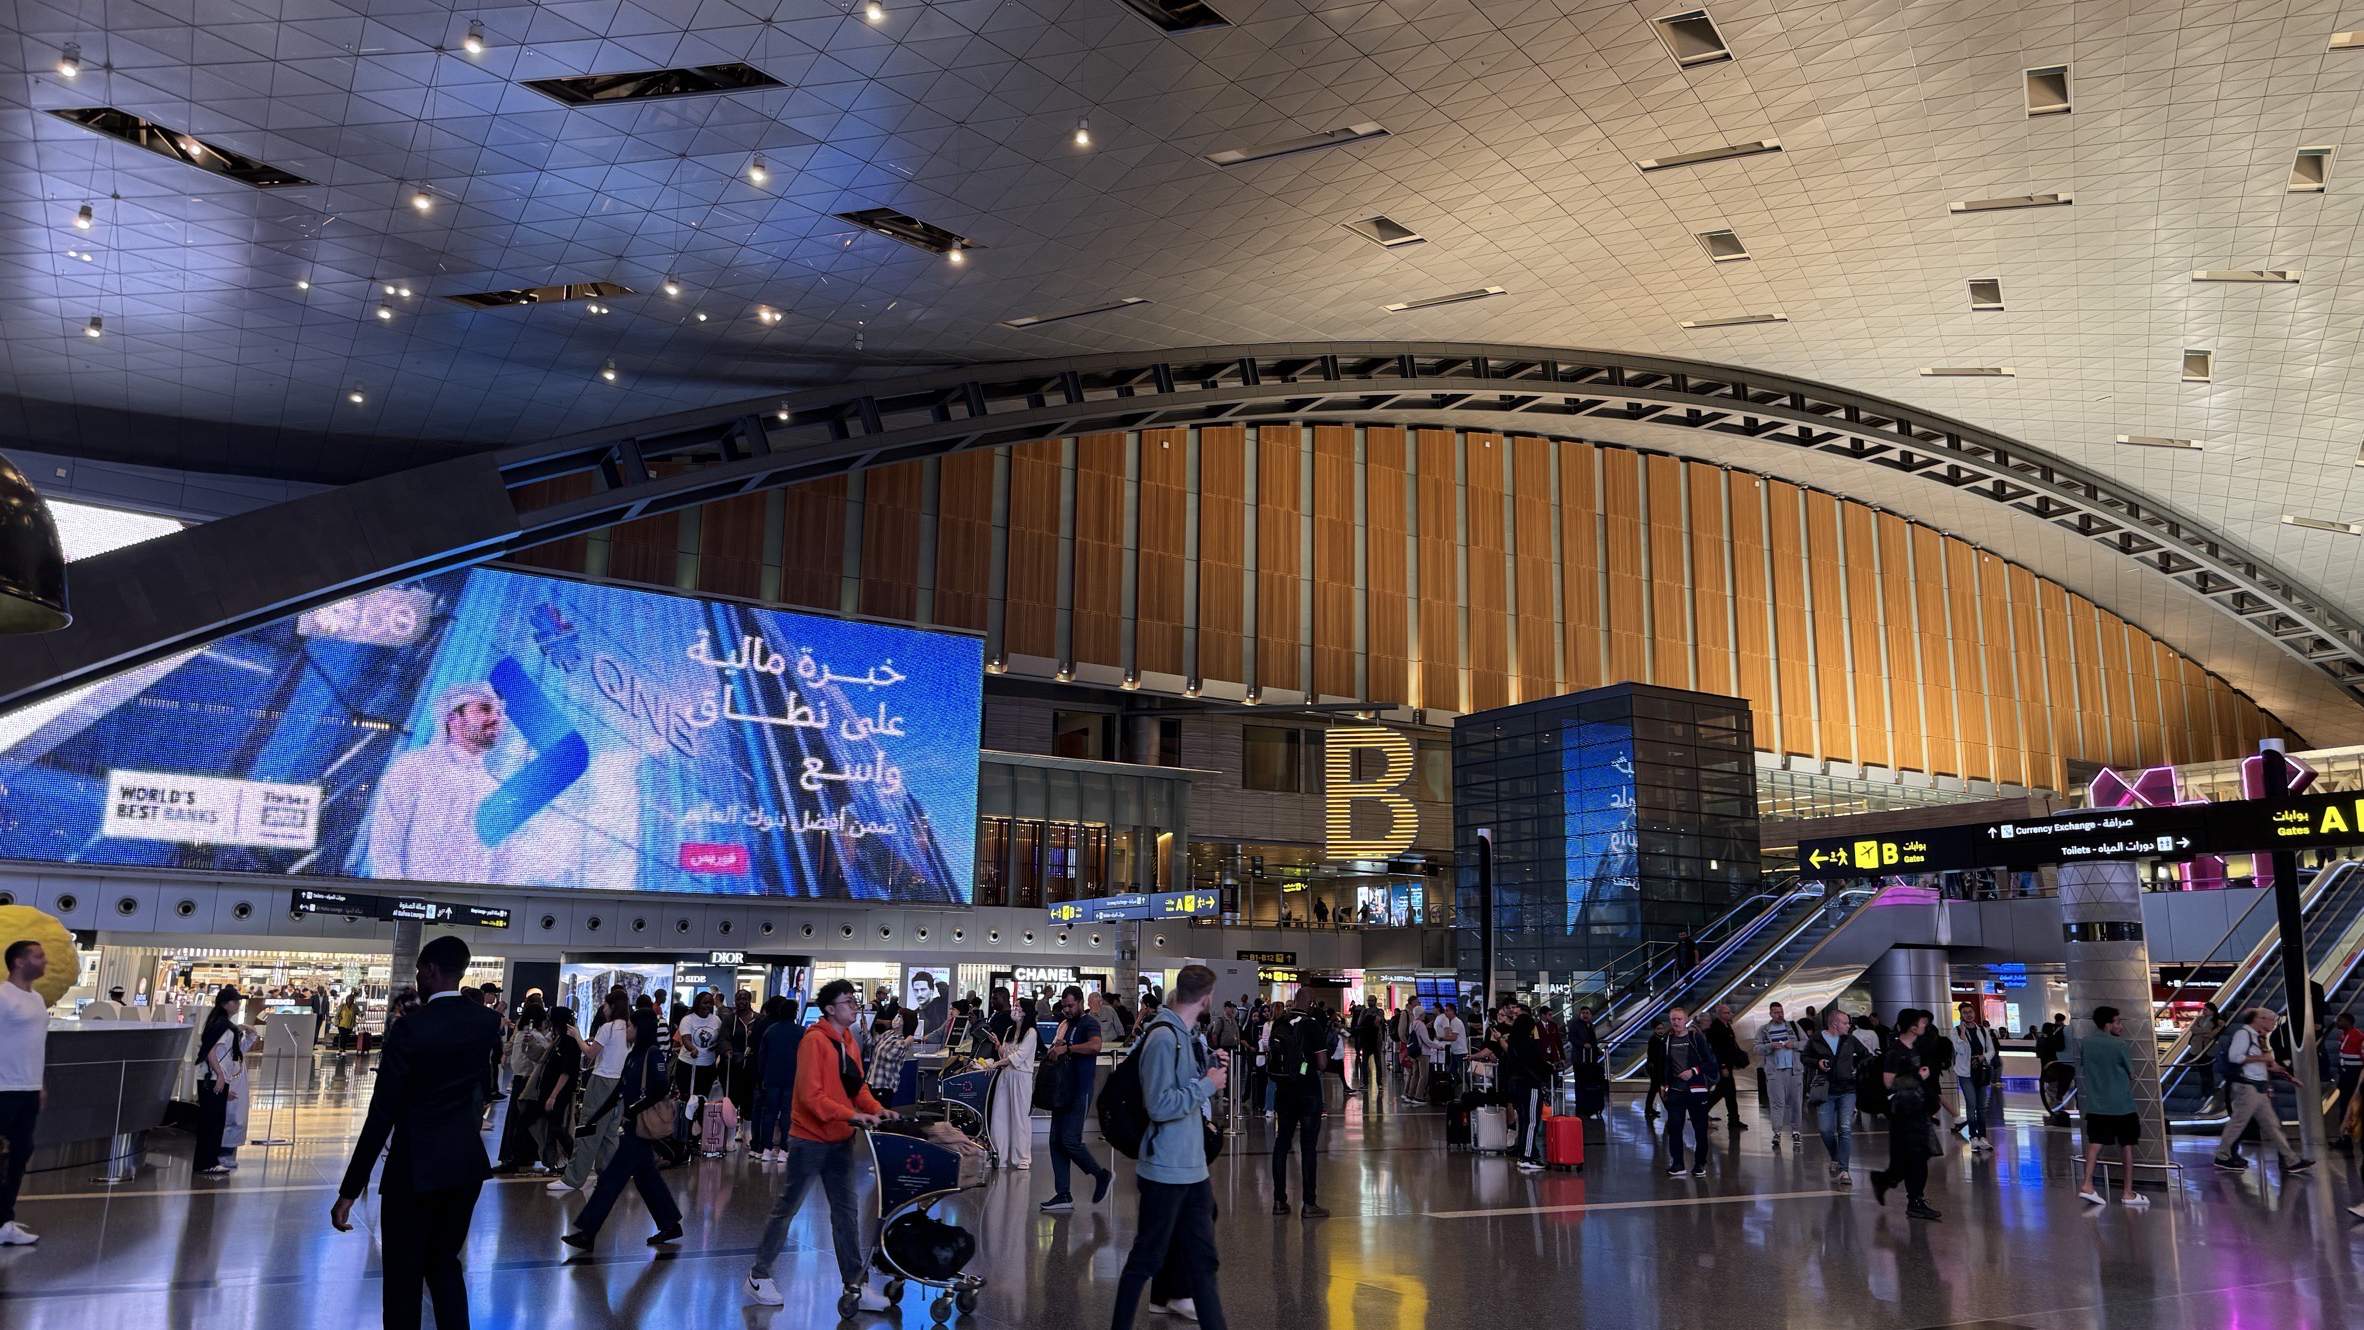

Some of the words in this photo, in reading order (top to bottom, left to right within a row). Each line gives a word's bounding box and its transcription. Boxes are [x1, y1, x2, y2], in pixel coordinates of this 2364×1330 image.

[686, 628, 785, 675] مالية
[798, 647, 907, 691] خبرة
[590, 658, 695, 759] QNB
[684, 684, 829, 728] نطاق
[841, 702, 905, 740] على
[800, 750, 901, 794] واسع
[118, 786, 197, 805] WORLD'S
[1326, 727, 1418, 859] B
[116, 804, 160, 820] BEST
[2273, 809, 2309, 822] بوابات
[2016, 823, 2053, 836] Currency
[2054, 820, 2096, 833] Exchange
[2103, 817, 2134, 828] صرافة
[2277, 825, 2310, 837] Gates
[2320, 805, 2348, 834] A
[1882, 842, 1899, 865] B
[1903, 854, 1925, 864] Gates
[1903, 841, 1927, 852] بوابات
[2061, 845, 2091, 856] Toilets
[2098, 842, 2123, 855] المياه
[2126, 841, 2155, 853] دورات
[1069, 906, 1075, 918] B
[1176, 898, 1183, 911] A
[711, 951, 744, 964] DIOR
[1249, 953, 1274, 962] B1-B12
[685, 975, 707, 983] SIDE
[1015, 967, 1077, 983] CHANEL
